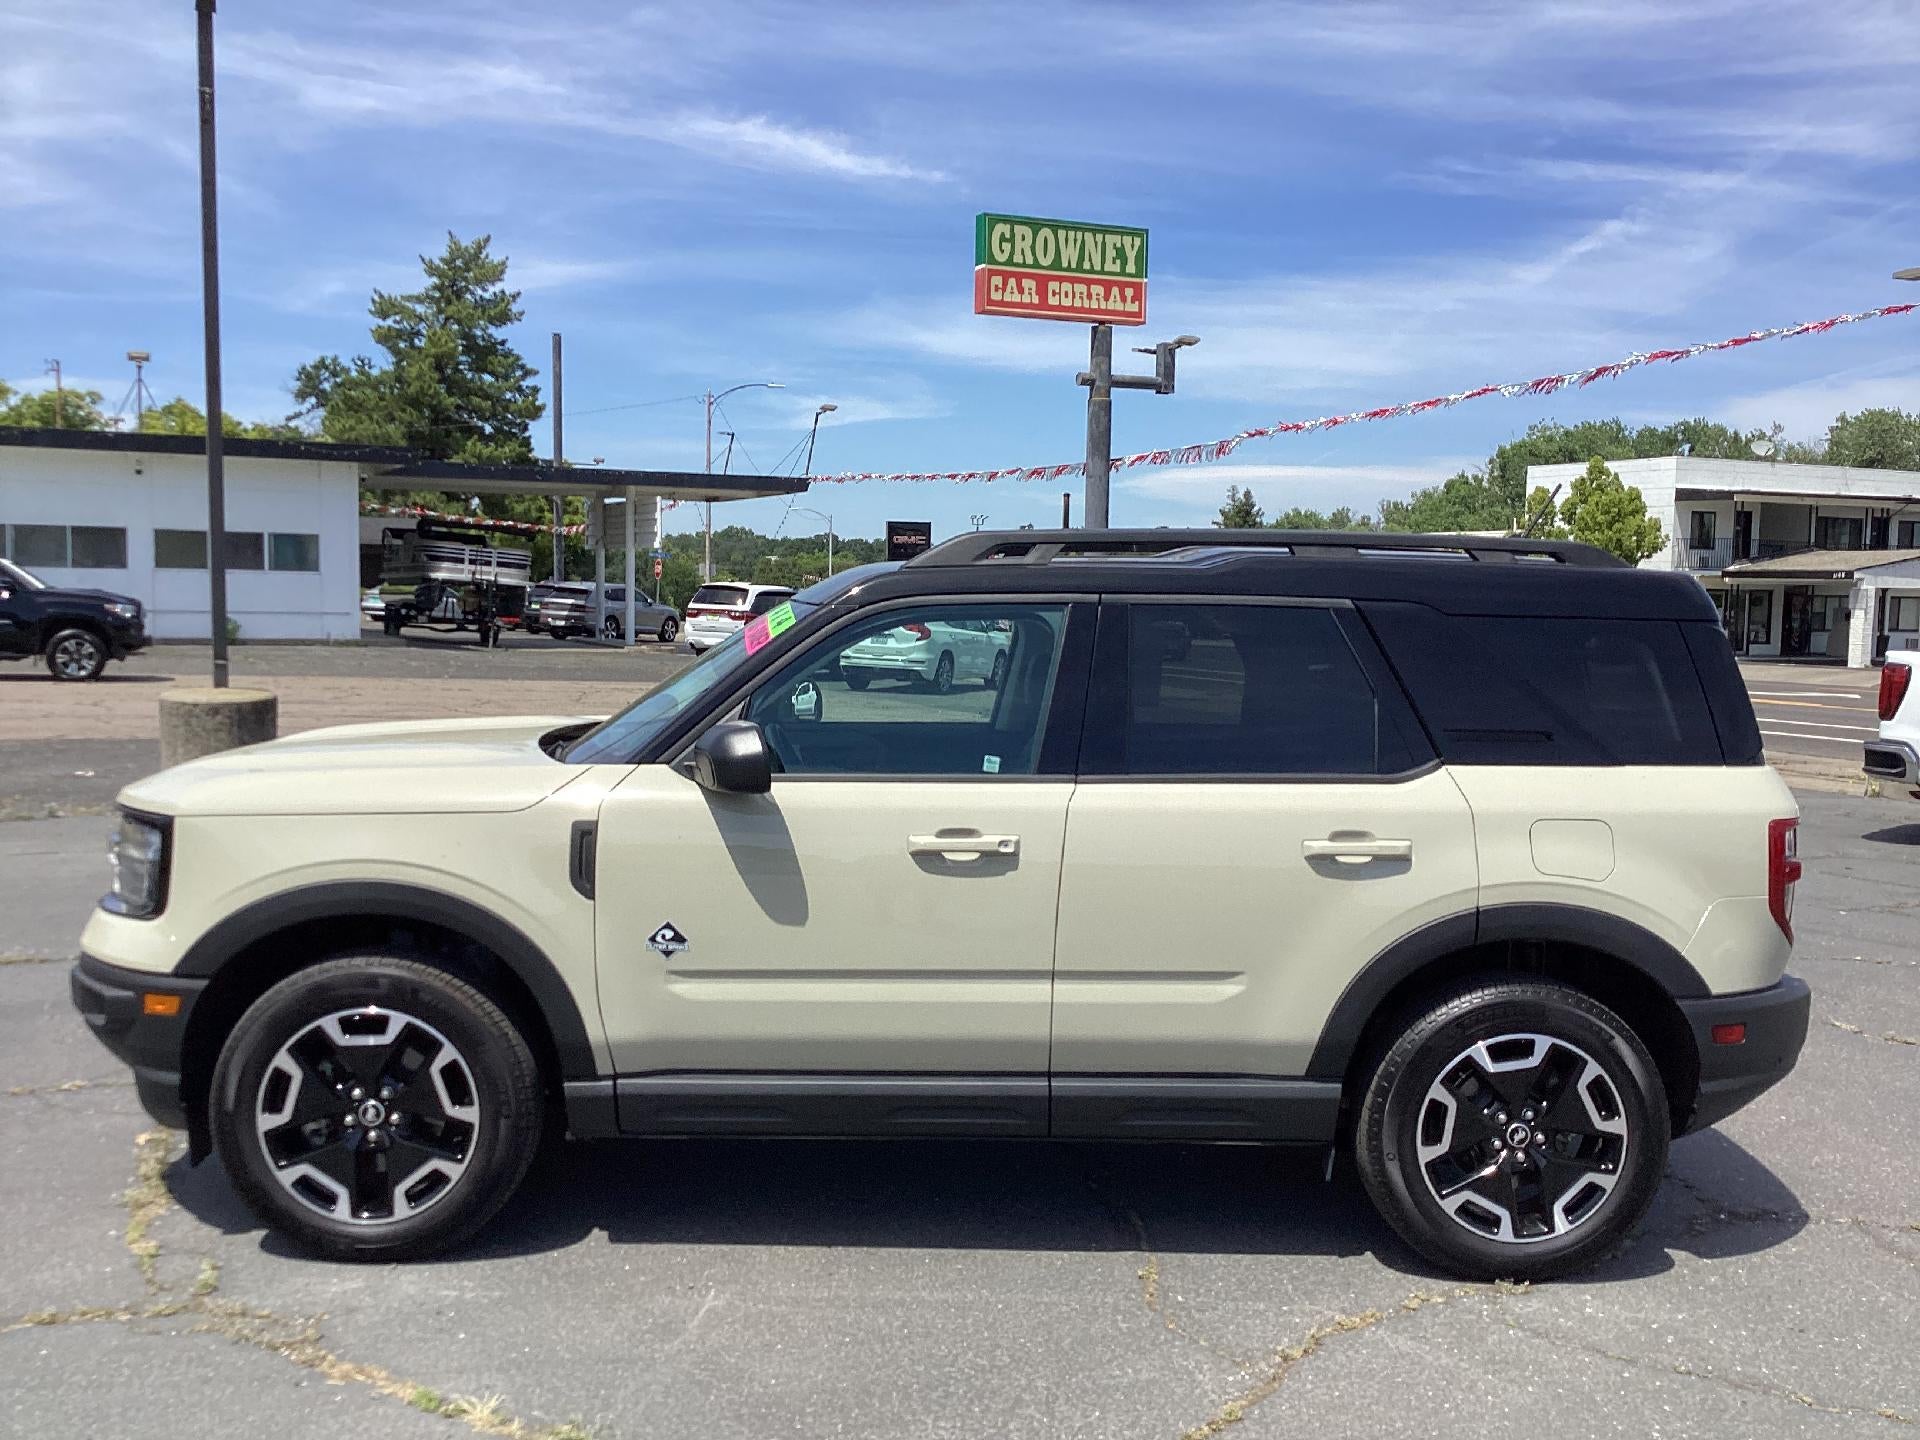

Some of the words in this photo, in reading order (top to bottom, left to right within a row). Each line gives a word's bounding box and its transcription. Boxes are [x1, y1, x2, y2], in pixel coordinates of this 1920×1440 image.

[991, 223, 1141, 274] GROWNEY
[990, 276, 1039, 304] CAR
[1048, 281, 1139, 312] CORRAL
